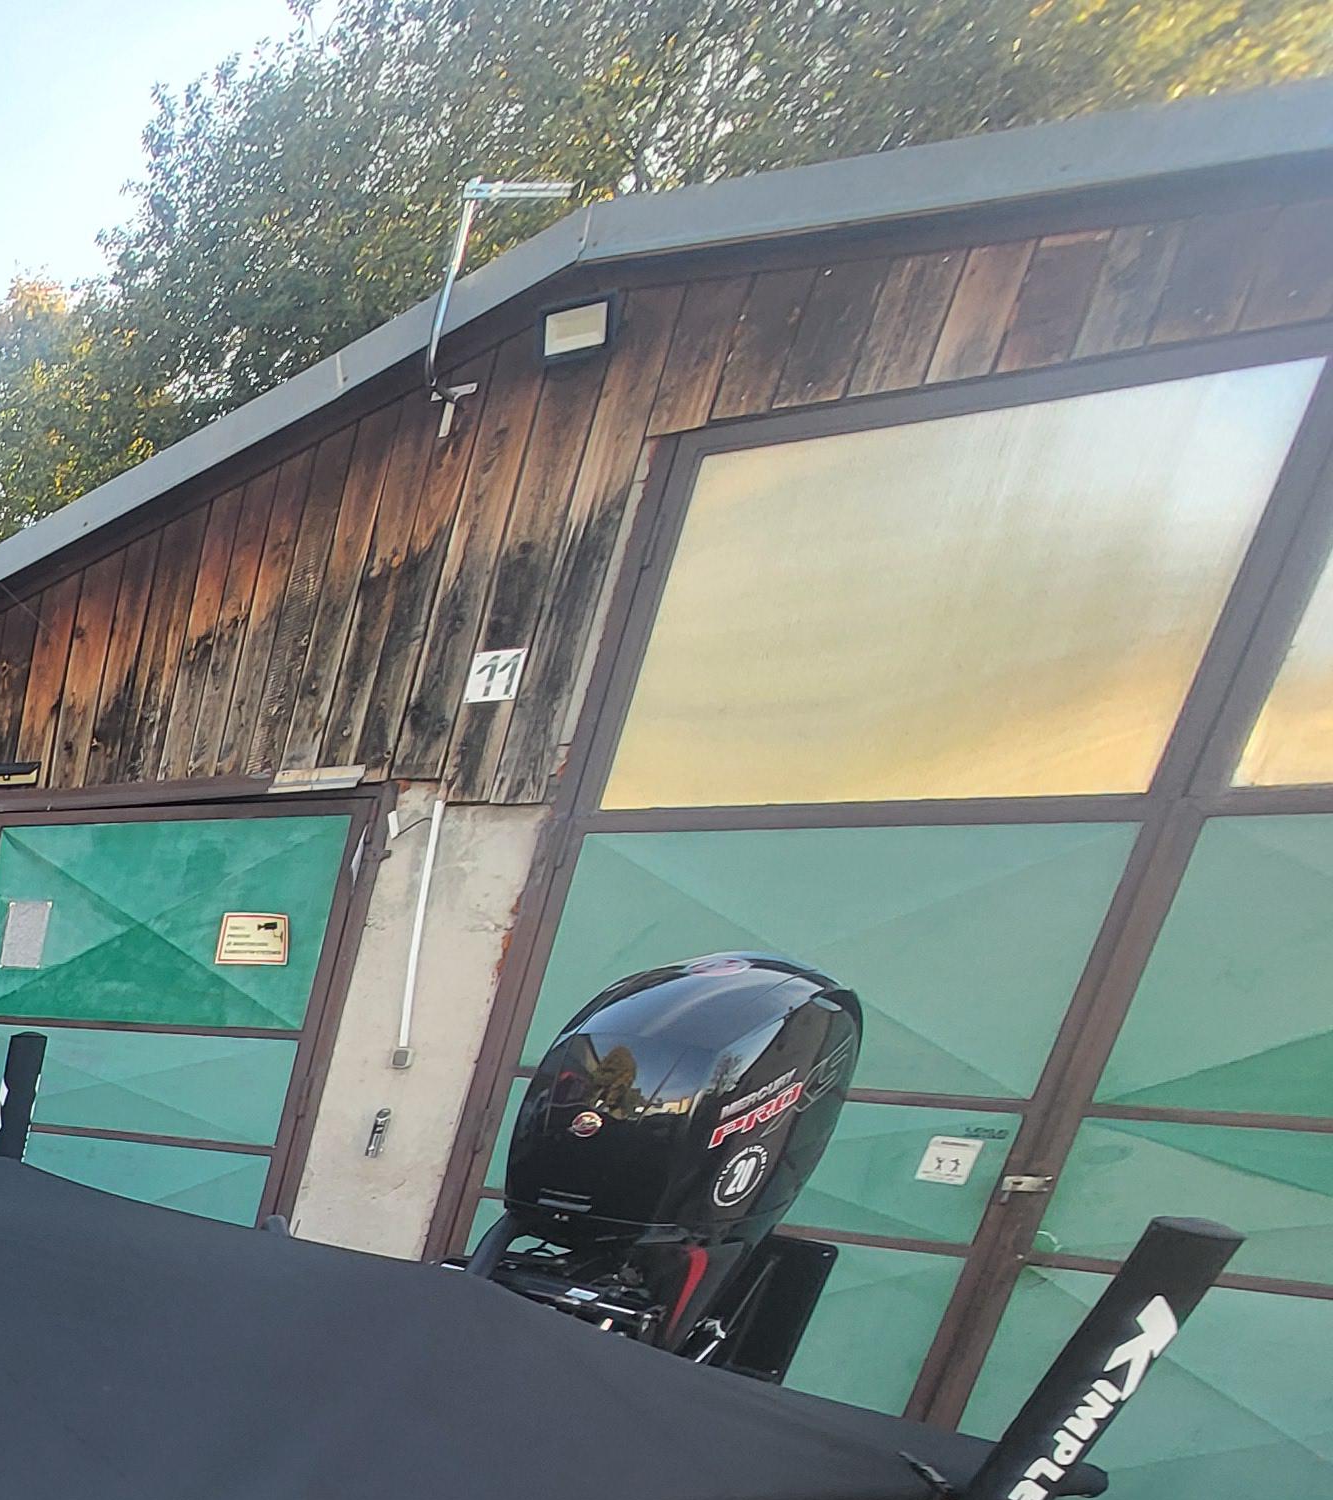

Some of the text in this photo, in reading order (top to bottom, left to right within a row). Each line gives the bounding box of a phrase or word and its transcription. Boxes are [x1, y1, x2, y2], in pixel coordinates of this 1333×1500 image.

[476, 653, 522, 697] 11
[707, 1081, 805, 1150] PRO
[720, 1067, 798, 1120] MERCURY
[723, 1156, 758, 1197] 20
